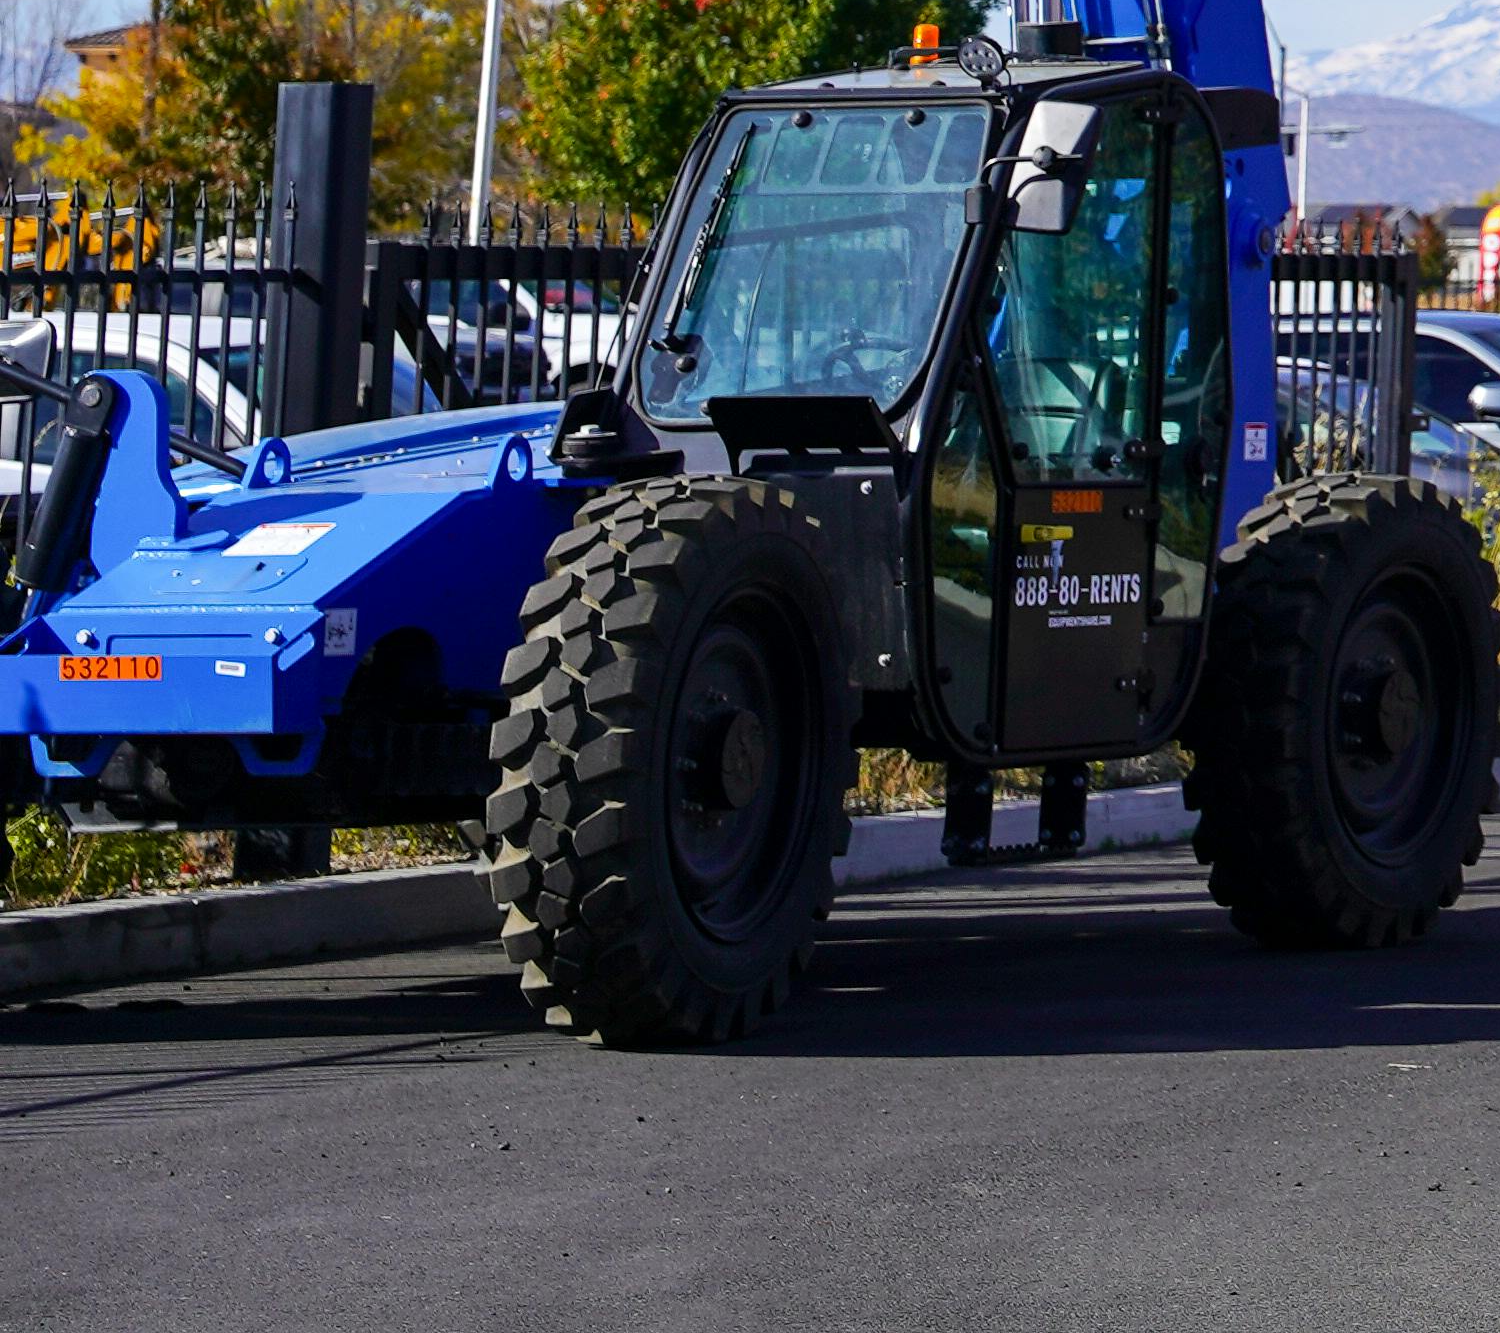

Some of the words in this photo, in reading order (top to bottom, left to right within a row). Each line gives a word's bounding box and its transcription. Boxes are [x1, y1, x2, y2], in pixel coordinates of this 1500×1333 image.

[1016, 555, 1040, 569] CALL
[1015, 573, 1141, 607] 888-80-RENTS
[62, 656, 160, 680] 532110
